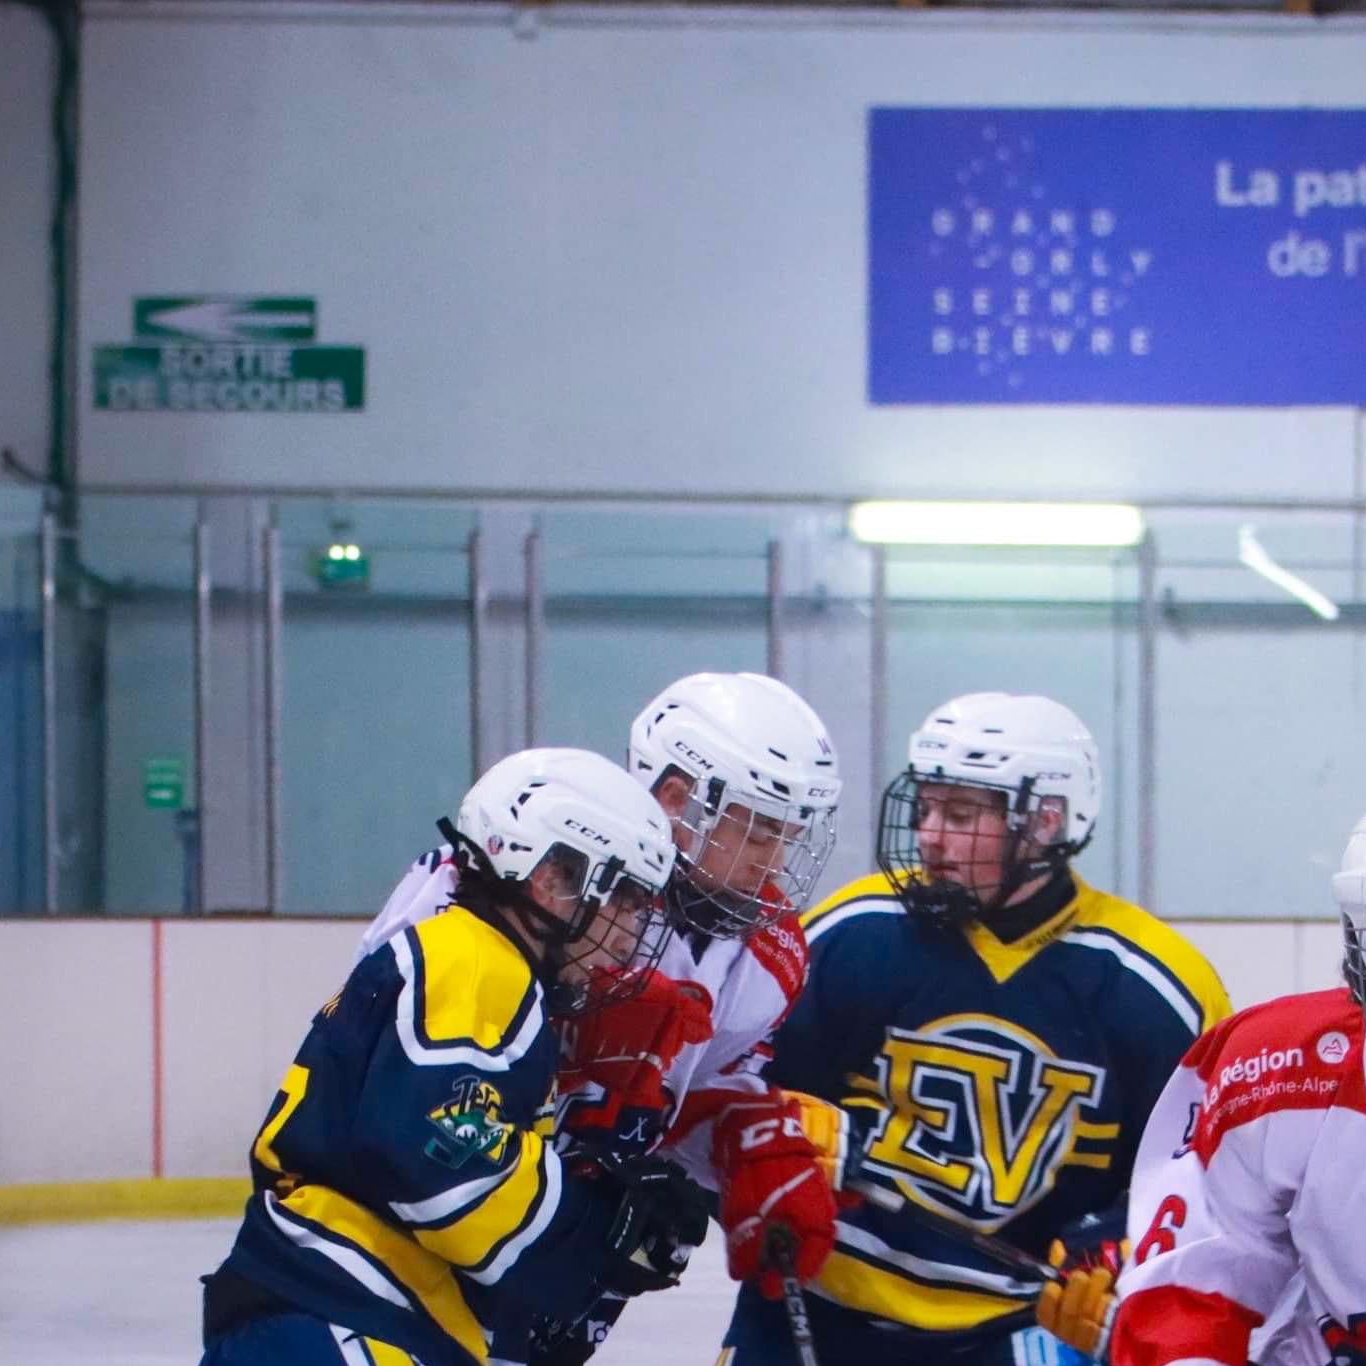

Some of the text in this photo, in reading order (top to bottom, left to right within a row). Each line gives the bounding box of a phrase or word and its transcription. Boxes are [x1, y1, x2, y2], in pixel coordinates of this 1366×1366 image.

[1215, 160, 1278, 207] La
[1267, 231, 1330, 277] de
[674, 740, 715, 771] CCM
[563, 818, 612, 847] CCM
[1219, 1047, 1304, 1089] Région
